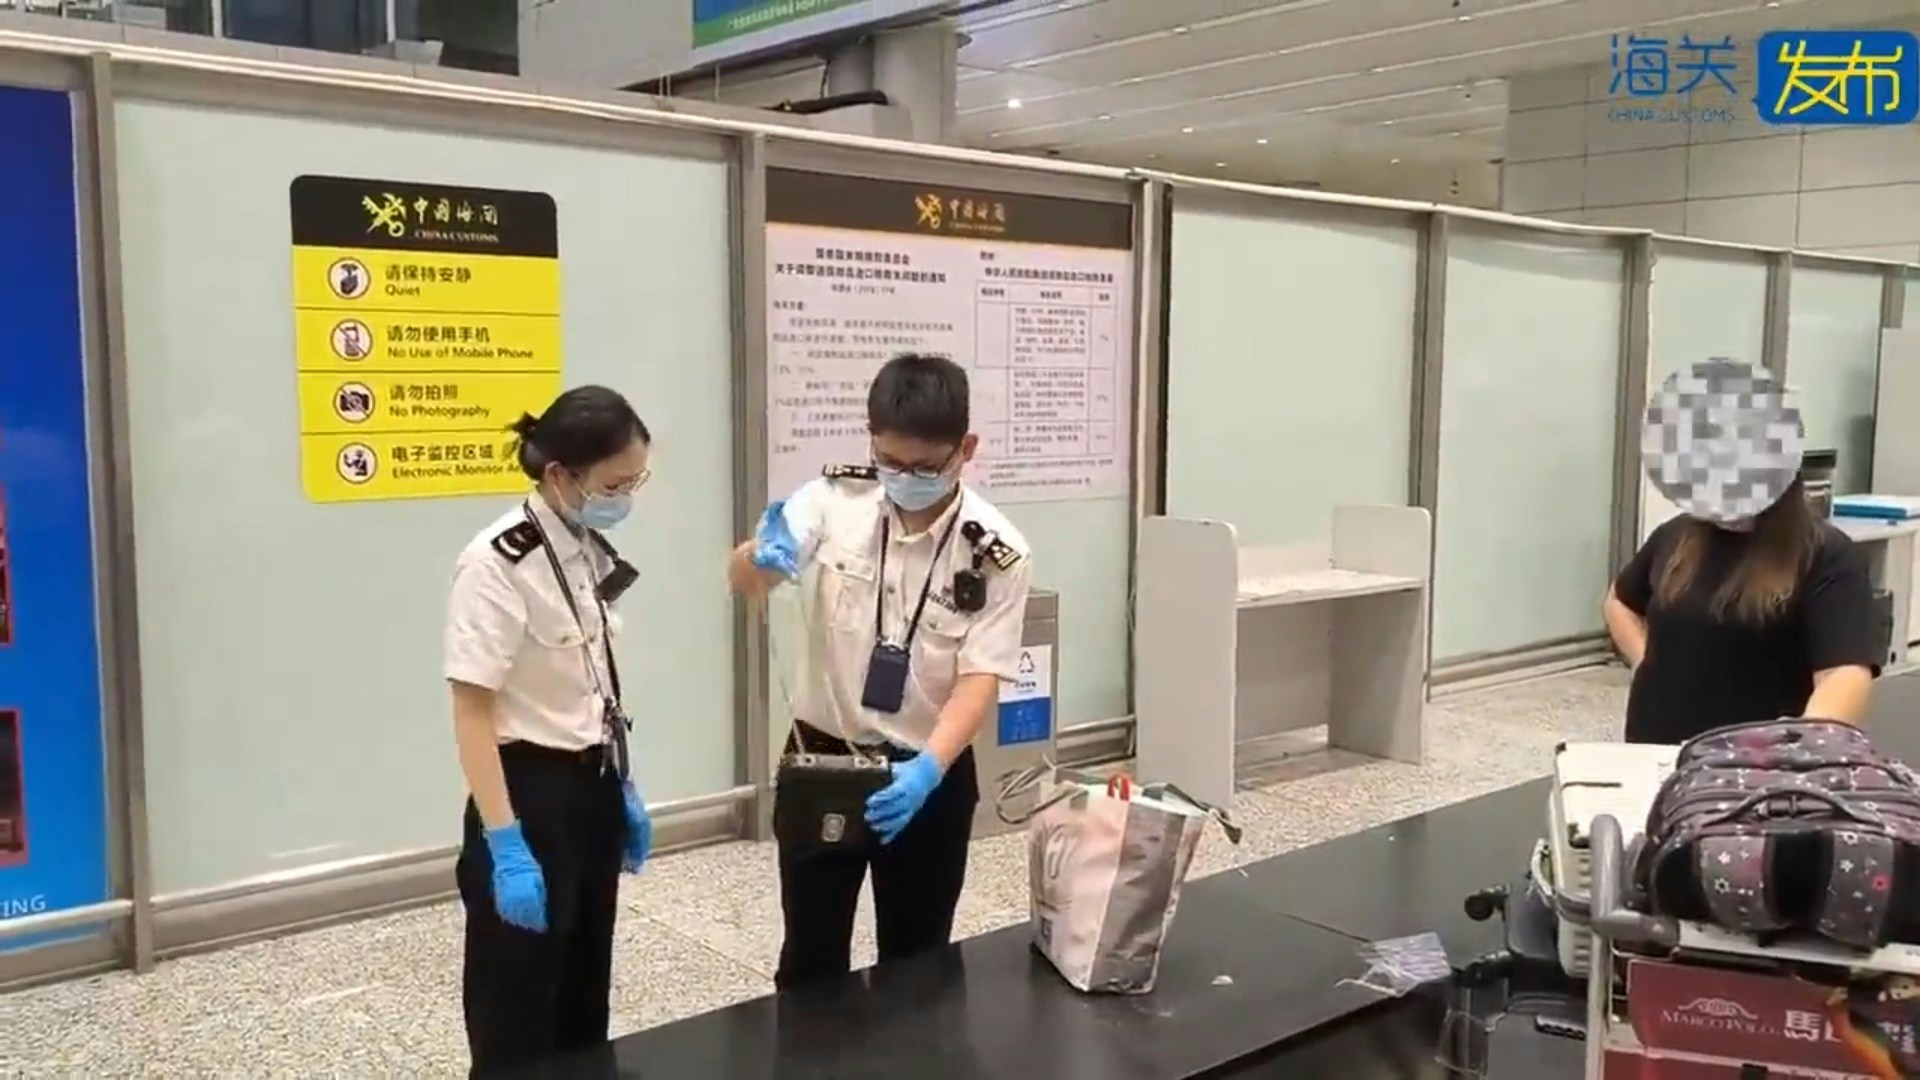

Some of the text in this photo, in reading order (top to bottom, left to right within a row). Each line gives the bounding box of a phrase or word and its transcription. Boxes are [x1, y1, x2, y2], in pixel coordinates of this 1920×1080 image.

[413, 196, 499, 225] 中国海关
[415, 229, 499, 243] CHINA CUSTOMS
[385, 264, 471, 283] 请保持安静
[385, 284, 421, 298] Quiet
[387, 325, 490, 344] 请勿使用手机
[388, 346, 534, 360] No Use of Mobile Phone
[389, 384, 458, 401] 请勿拍照
[390, 404, 490, 419] No Photography
[392, 444, 493, 462] 电子监控区域
[392, 464, 452, 480] Electronic
[455, 463, 504, 477] Monitor
[0, 894, 46, 917] ING
[1660, 1009, 1725, 1029] MARCO
